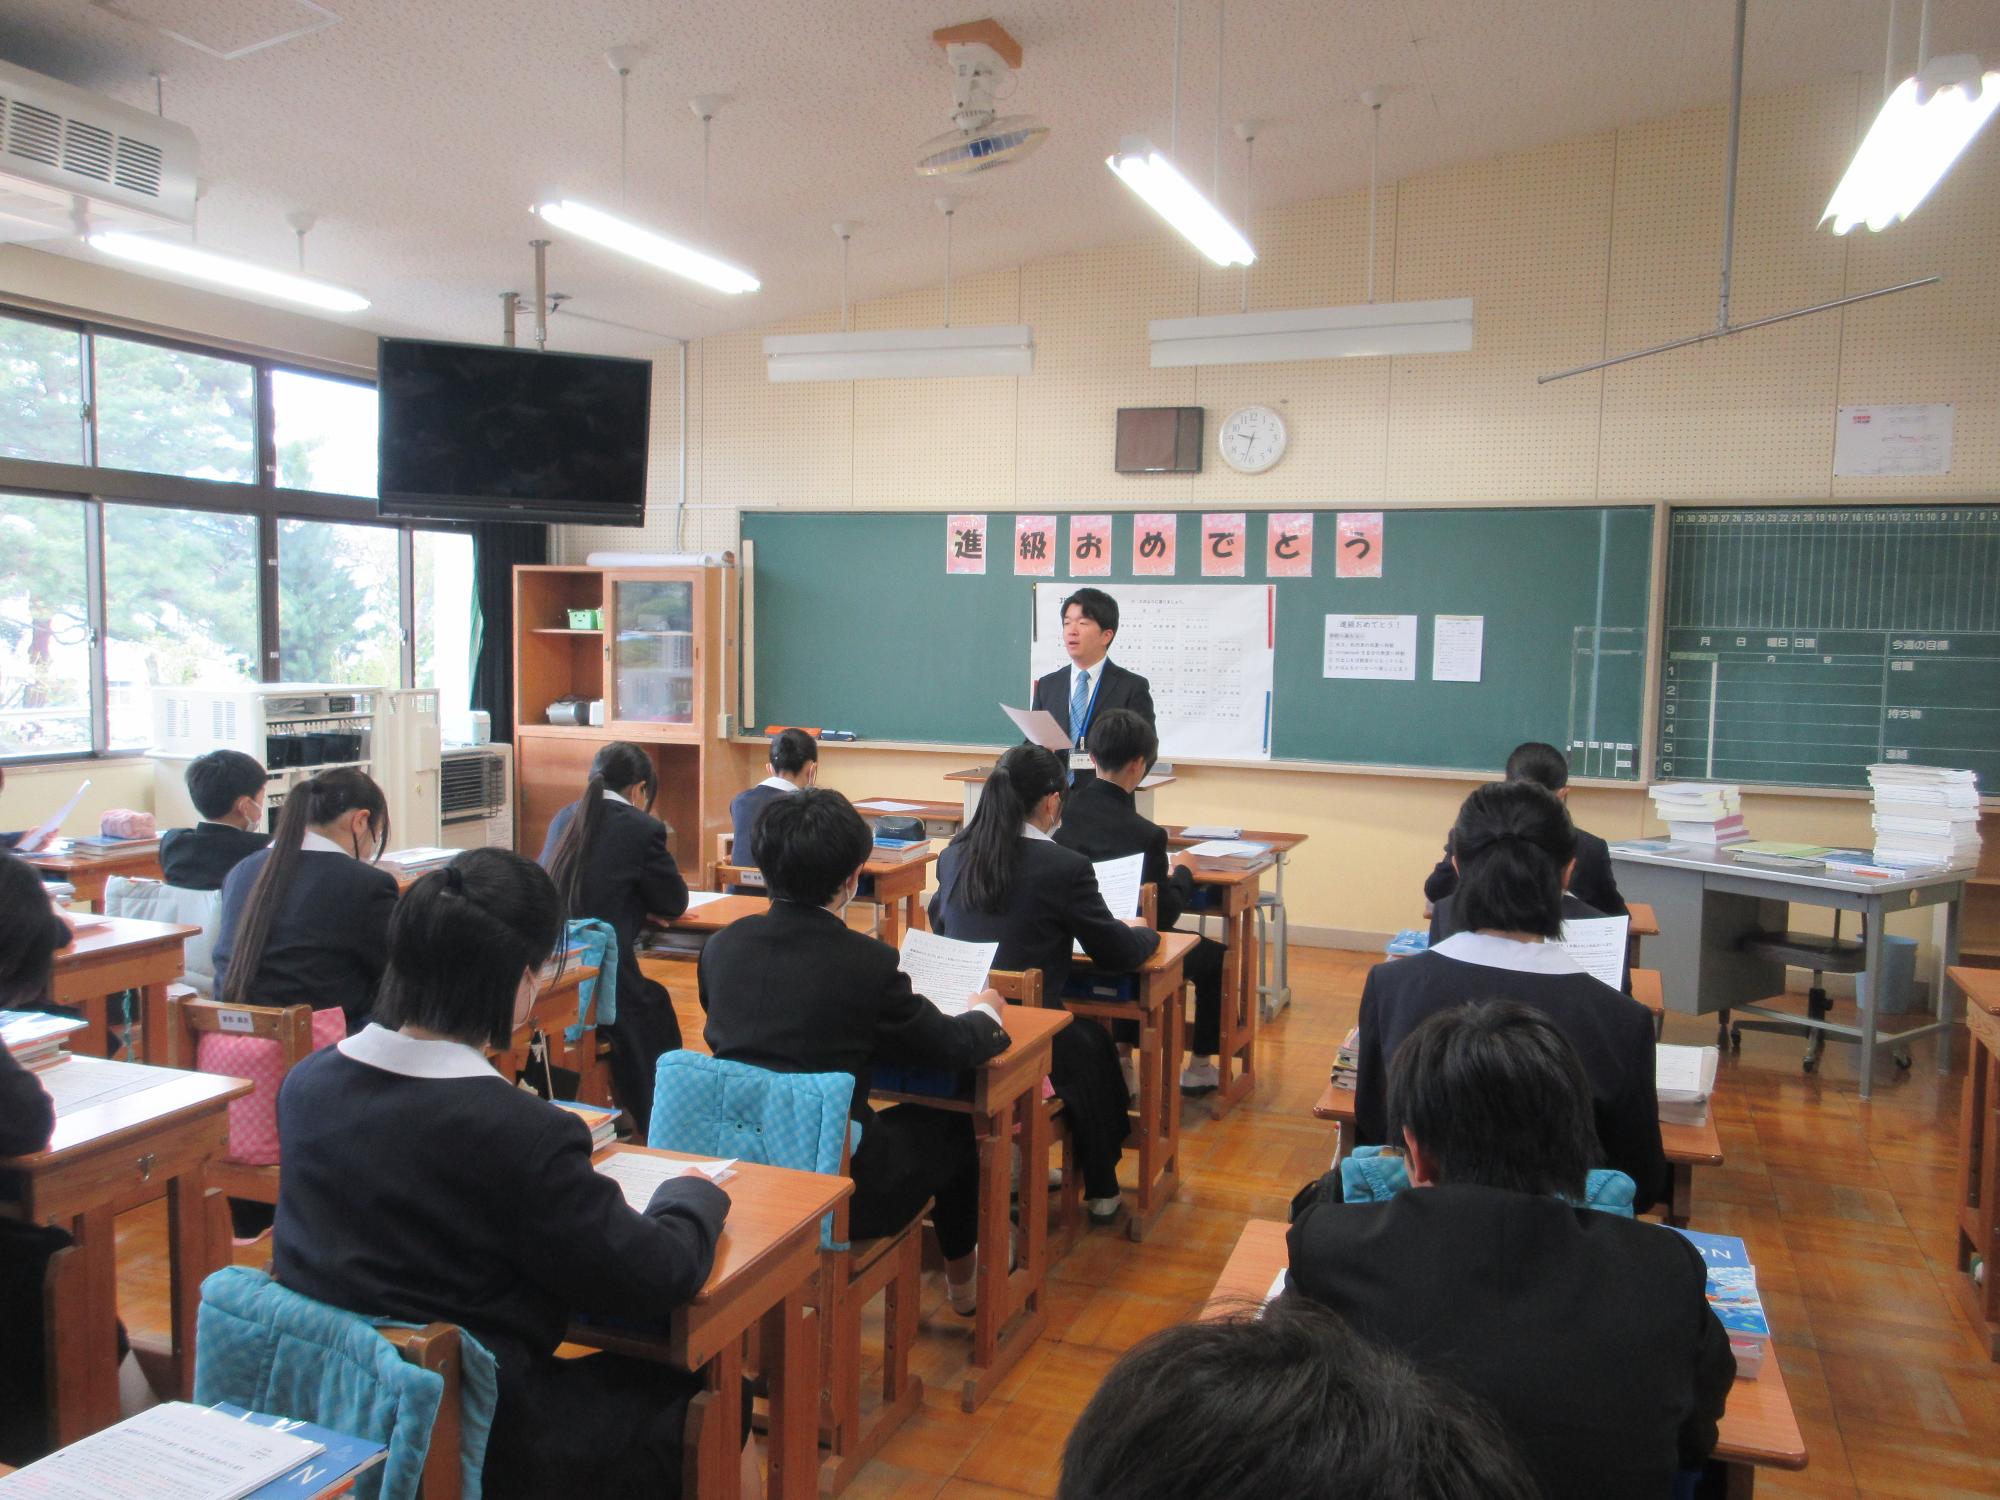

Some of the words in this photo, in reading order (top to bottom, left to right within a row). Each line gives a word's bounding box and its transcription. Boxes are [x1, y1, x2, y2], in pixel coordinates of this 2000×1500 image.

[1675, 513, 1684, 522] 31
[1698, 513, 1707, 522] 29
[1720, 513, 1730, 522] 27
[1744, 513, 1754, 522] 25
[1755, 513, 1765, 522] 24
[1779, 513, 1788, 522] 22
[1791, 513, 1800, 522] 21
[1815, 513, 1825, 522] 19
[1839, 512, 1849, 521] 17
[1852, 512, 1862, 521] 16
[1864, 512, 1874, 521] 15
[1876, 512, 1886, 521] 14
[1888, 512, 1898, 521] 13
[1901, 512, 1911, 521] 12
[1914, 512, 1924, 521] 11
[1926, 512, 1936, 521] 10
[1940, 512, 1947, 521] 9
[1966, 512, 1972, 521] 7
[1992, 512, 1998, 521] 5
[955, 529, 1370, 560] 進級おめでとう
[1700, 636, 1711, 646] 月
[1736, 637, 1746, 647] 日
[1767, 637, 1788, 648] 曜日
[1891, 639, 1949, 651] 今週の目標
[1668, 666, 1674, 676] 1
[1666, 685, 1676, 696] 2
[1665, 704, 1675, 715] 3
[1887, 708, 1922, 720] 持ち物
[1664, 724, 1674, 734] 4
[1663, 743, 1673, 753] 5
[1663, 762, 1672, 772] 6
